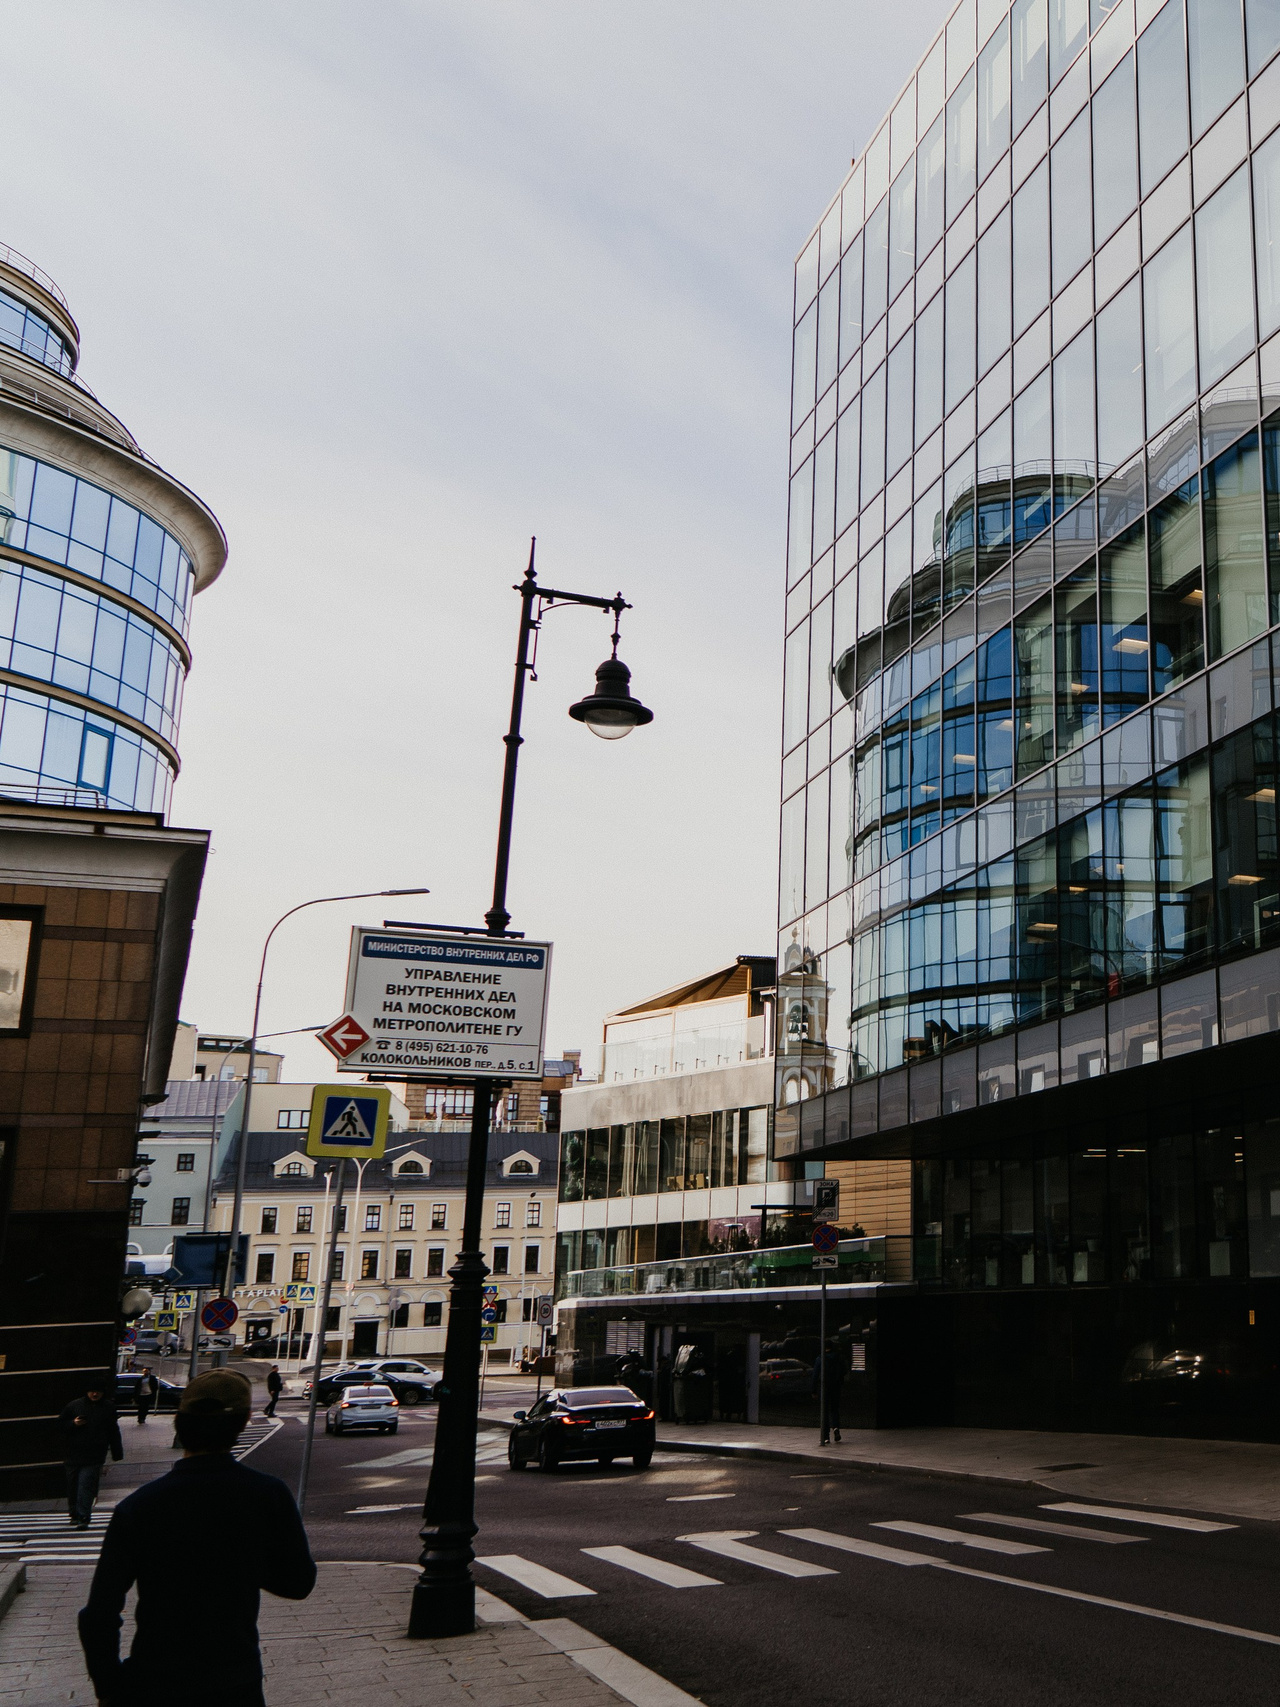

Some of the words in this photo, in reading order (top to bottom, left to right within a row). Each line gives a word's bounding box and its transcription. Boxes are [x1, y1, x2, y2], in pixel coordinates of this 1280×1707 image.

[368, 941, 444, 955] МИНИСТЕРСТВО
[446, 948, 505, 960] ВНУТРЕННИХ
[506, 953, 524, 962] ДЕЛ
[525, 953, 539, 962] РФ
[405, 968, 502, 985] УПРАВЛЕНИЕ
[386, 984, 485, 1001] ВНУТРЕННИХ
[488, 992, 516, 1003] ДЕЛ
[383, 1001, 403, 1013] НА
[408, 1002, 516, 1019] МОСКОВСКОМ
[373, 1018, 502, 1035] МЕТРОПОЛИТЕНЕ
[506, 1026, 523, 1036] ГУ
[396, 1041, 402, 1050] 8
[405, 1041, 433, 1054] (495)
[436, 1043, 488, 1054] 621-10-76
[361, 1053, 471, 1067] КОЛОКОЛЬНИКОВ
